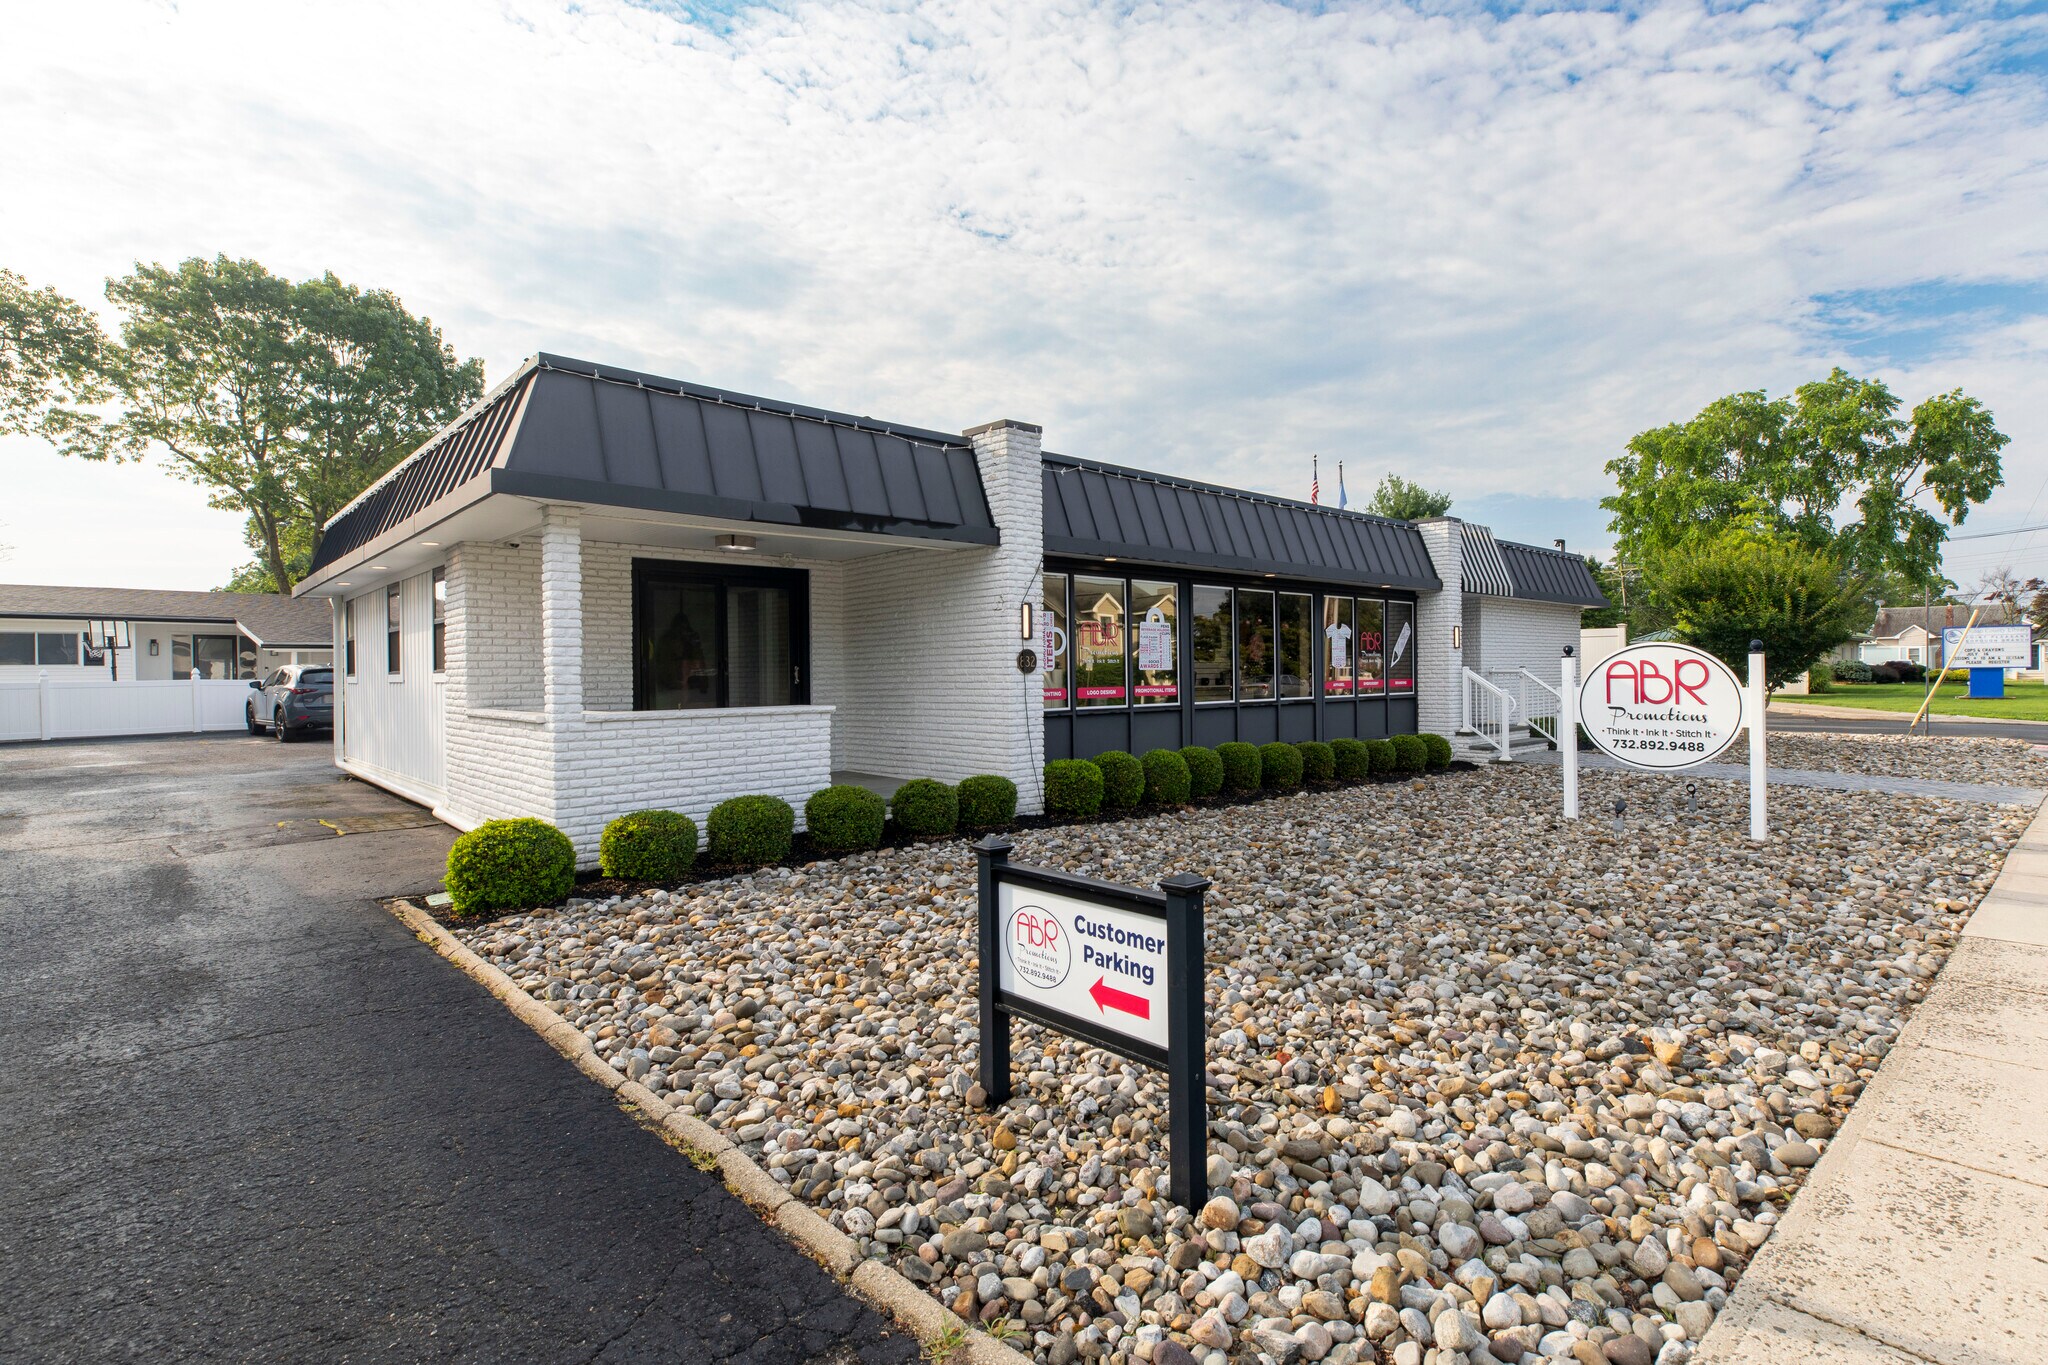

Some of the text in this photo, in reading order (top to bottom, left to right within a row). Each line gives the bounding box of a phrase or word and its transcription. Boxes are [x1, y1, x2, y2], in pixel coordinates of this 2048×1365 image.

[1605, 659, 1710, 705] ABR
[1607, 706, 1708, 726] Promotions
[1607, 728, 1711, 738] Think It Ink It Stitch It
[1612, 739, 1705, 752] 732.892.9488
[1017, 912, 1058, 952] ABR
[1074, 914, 1165, 955] Customer
[1017, 942, 1058, 964] Promotions
[1019, 965, 1057, 983] 732.892.9488
[1083, 944, 1154, 986] Parking
